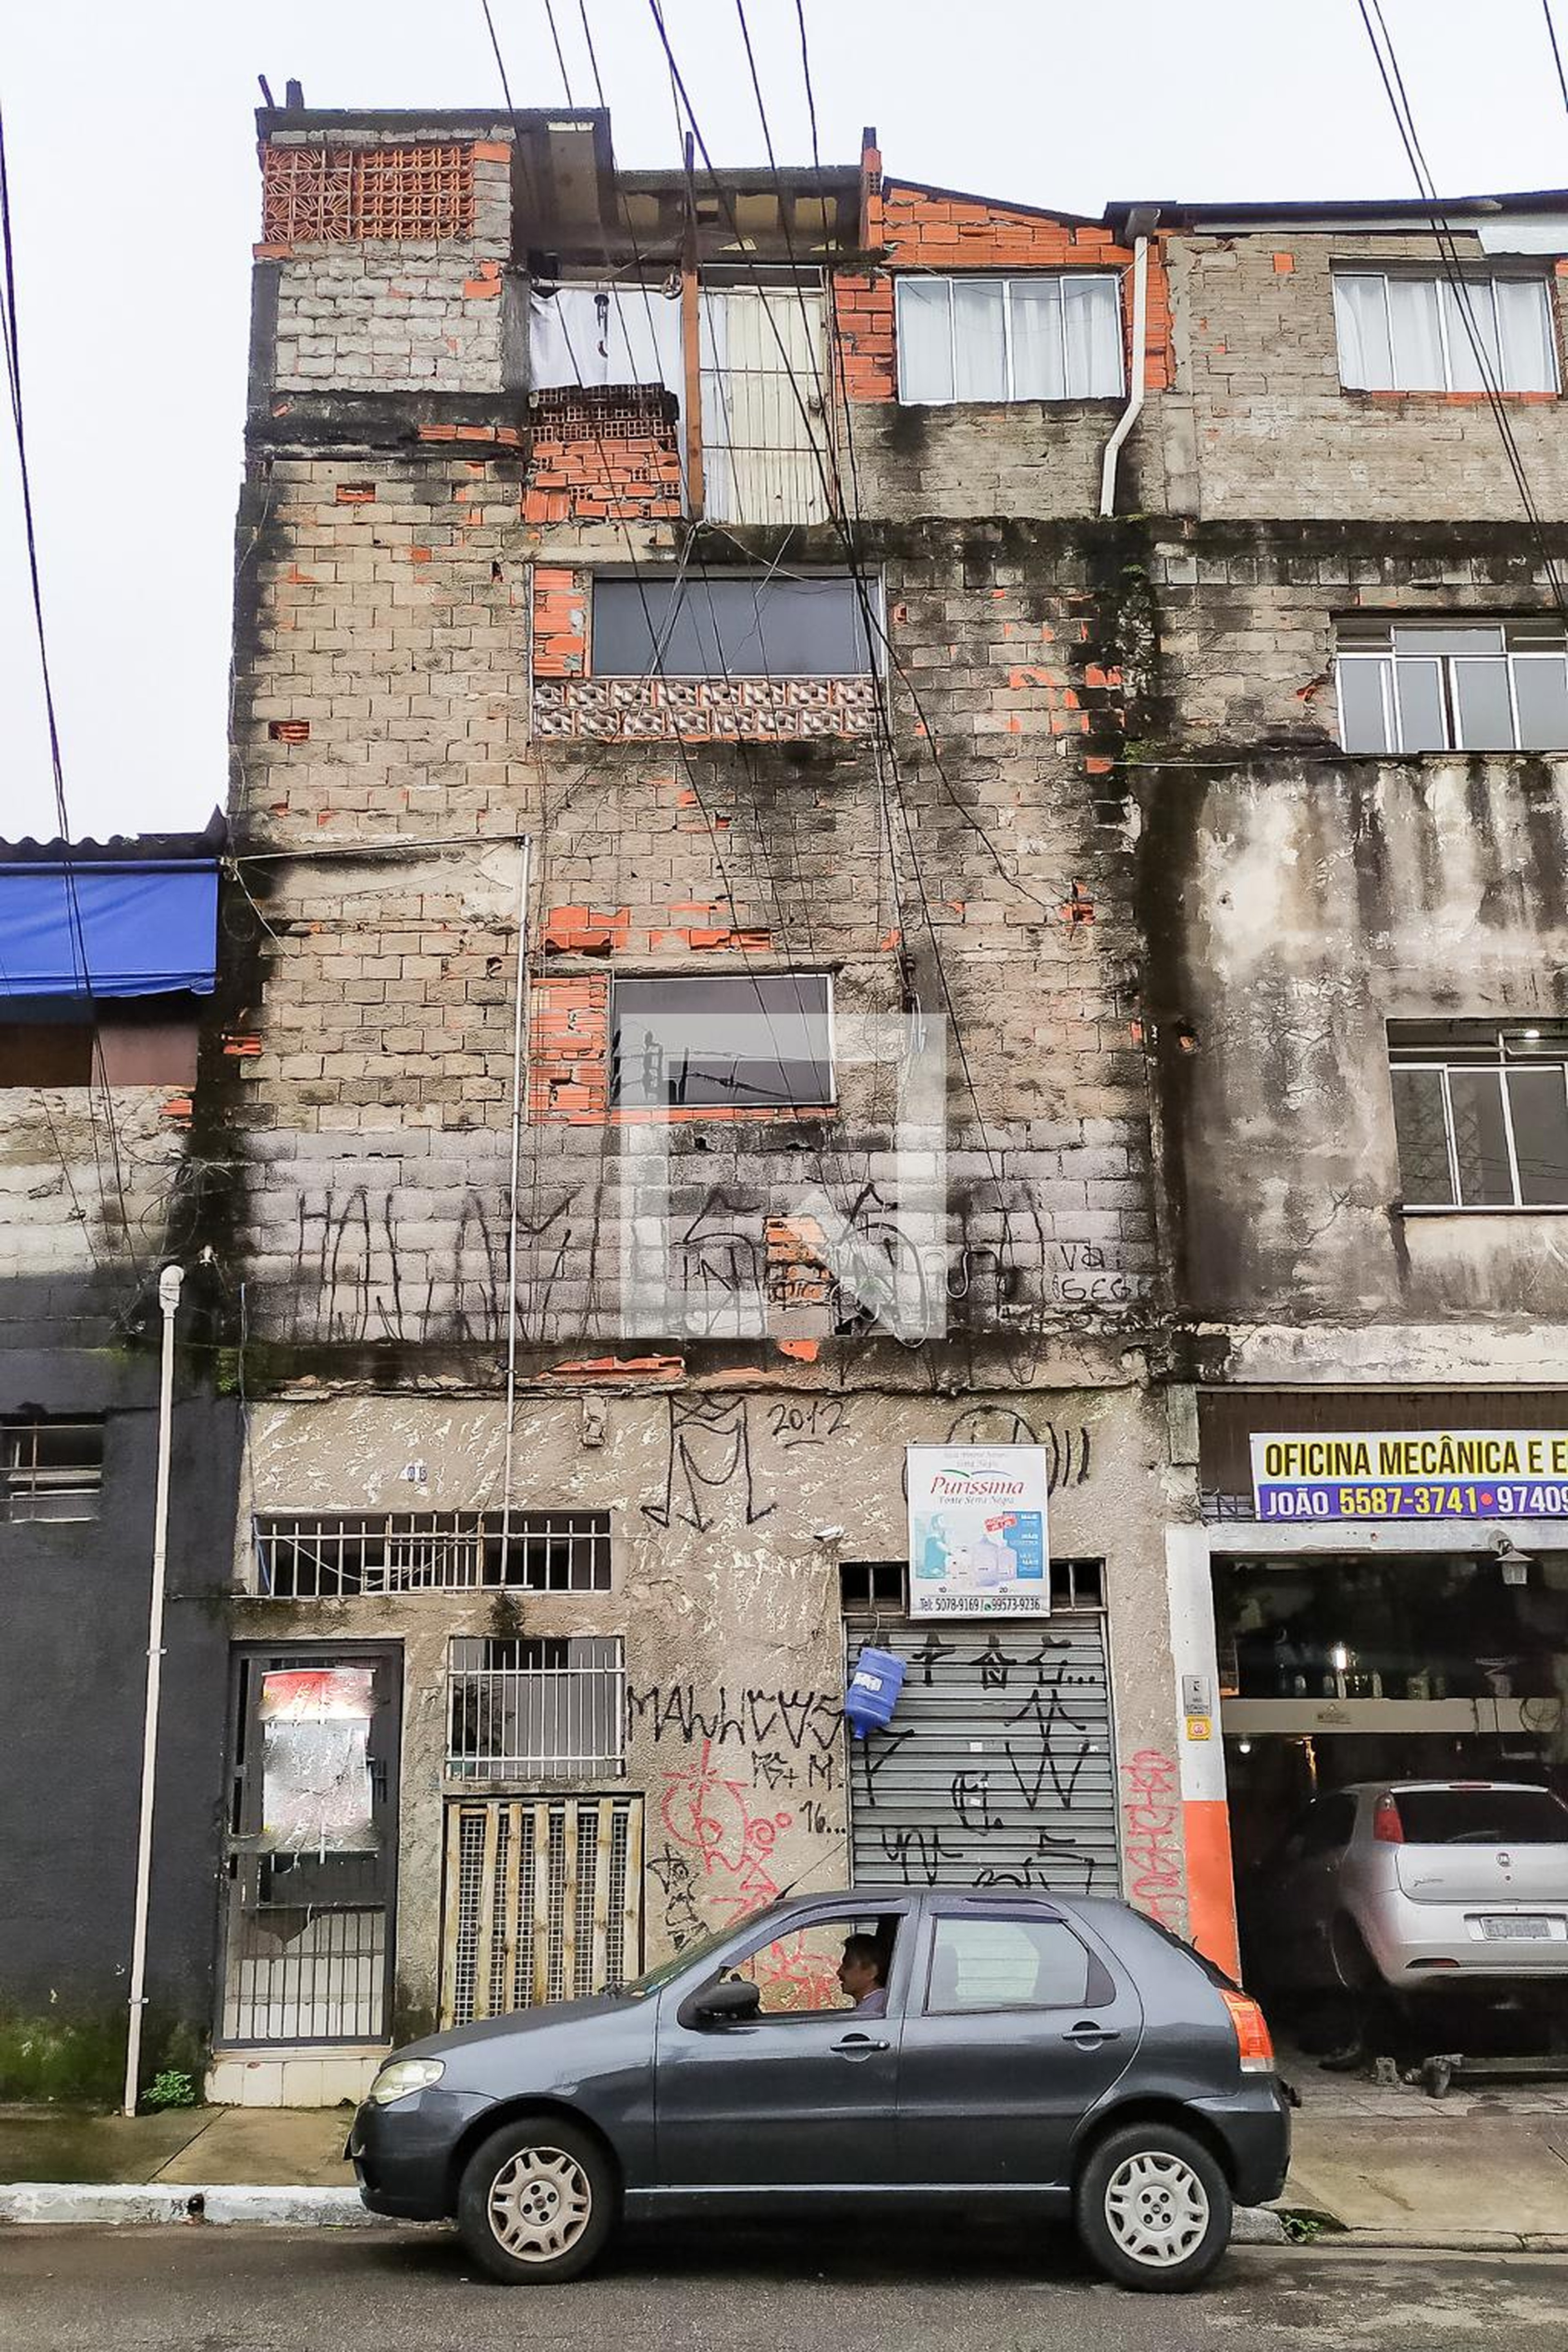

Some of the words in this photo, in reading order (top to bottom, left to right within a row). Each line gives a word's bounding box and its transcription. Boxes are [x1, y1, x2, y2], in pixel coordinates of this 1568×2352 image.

[768, 1401, 850, 1435] 2012
[1265, 1443, 1372, 1477] OFICINA
[1379, 1435, 1520, 1475] MECÂNICA
[1528, 1441, 1544, 1473] E
[1267, 1488, 1329, 1515] JOÃO
[1339, 1486, 1477, 1514] 5587-3741
[935, 1598, 979, 1611] 5078-9169
[992, 1598, 1040, 1611] 99573-9236
